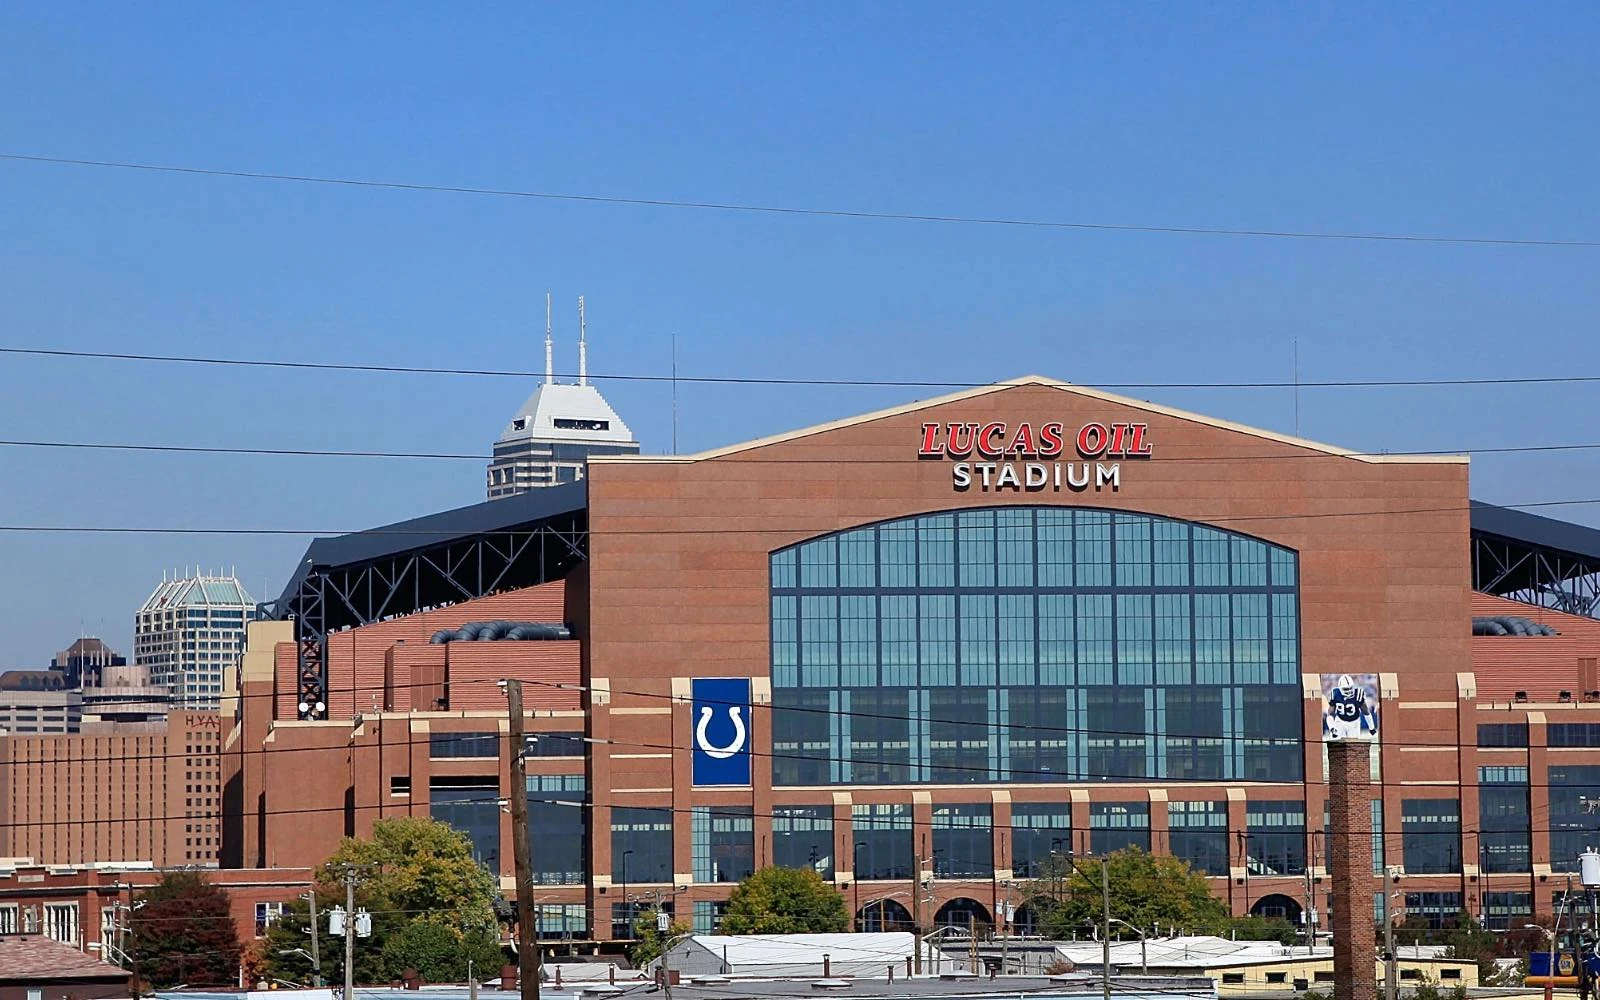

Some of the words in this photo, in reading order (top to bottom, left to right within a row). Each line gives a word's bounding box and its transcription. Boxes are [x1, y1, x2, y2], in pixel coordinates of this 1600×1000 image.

[919, 422, 1063, 456] LUCAS
[1077, 422, 1153, 456] OIL
[953, 462, 1120, 490] STADIUM
[1335, 702, 1356, 717] 93
